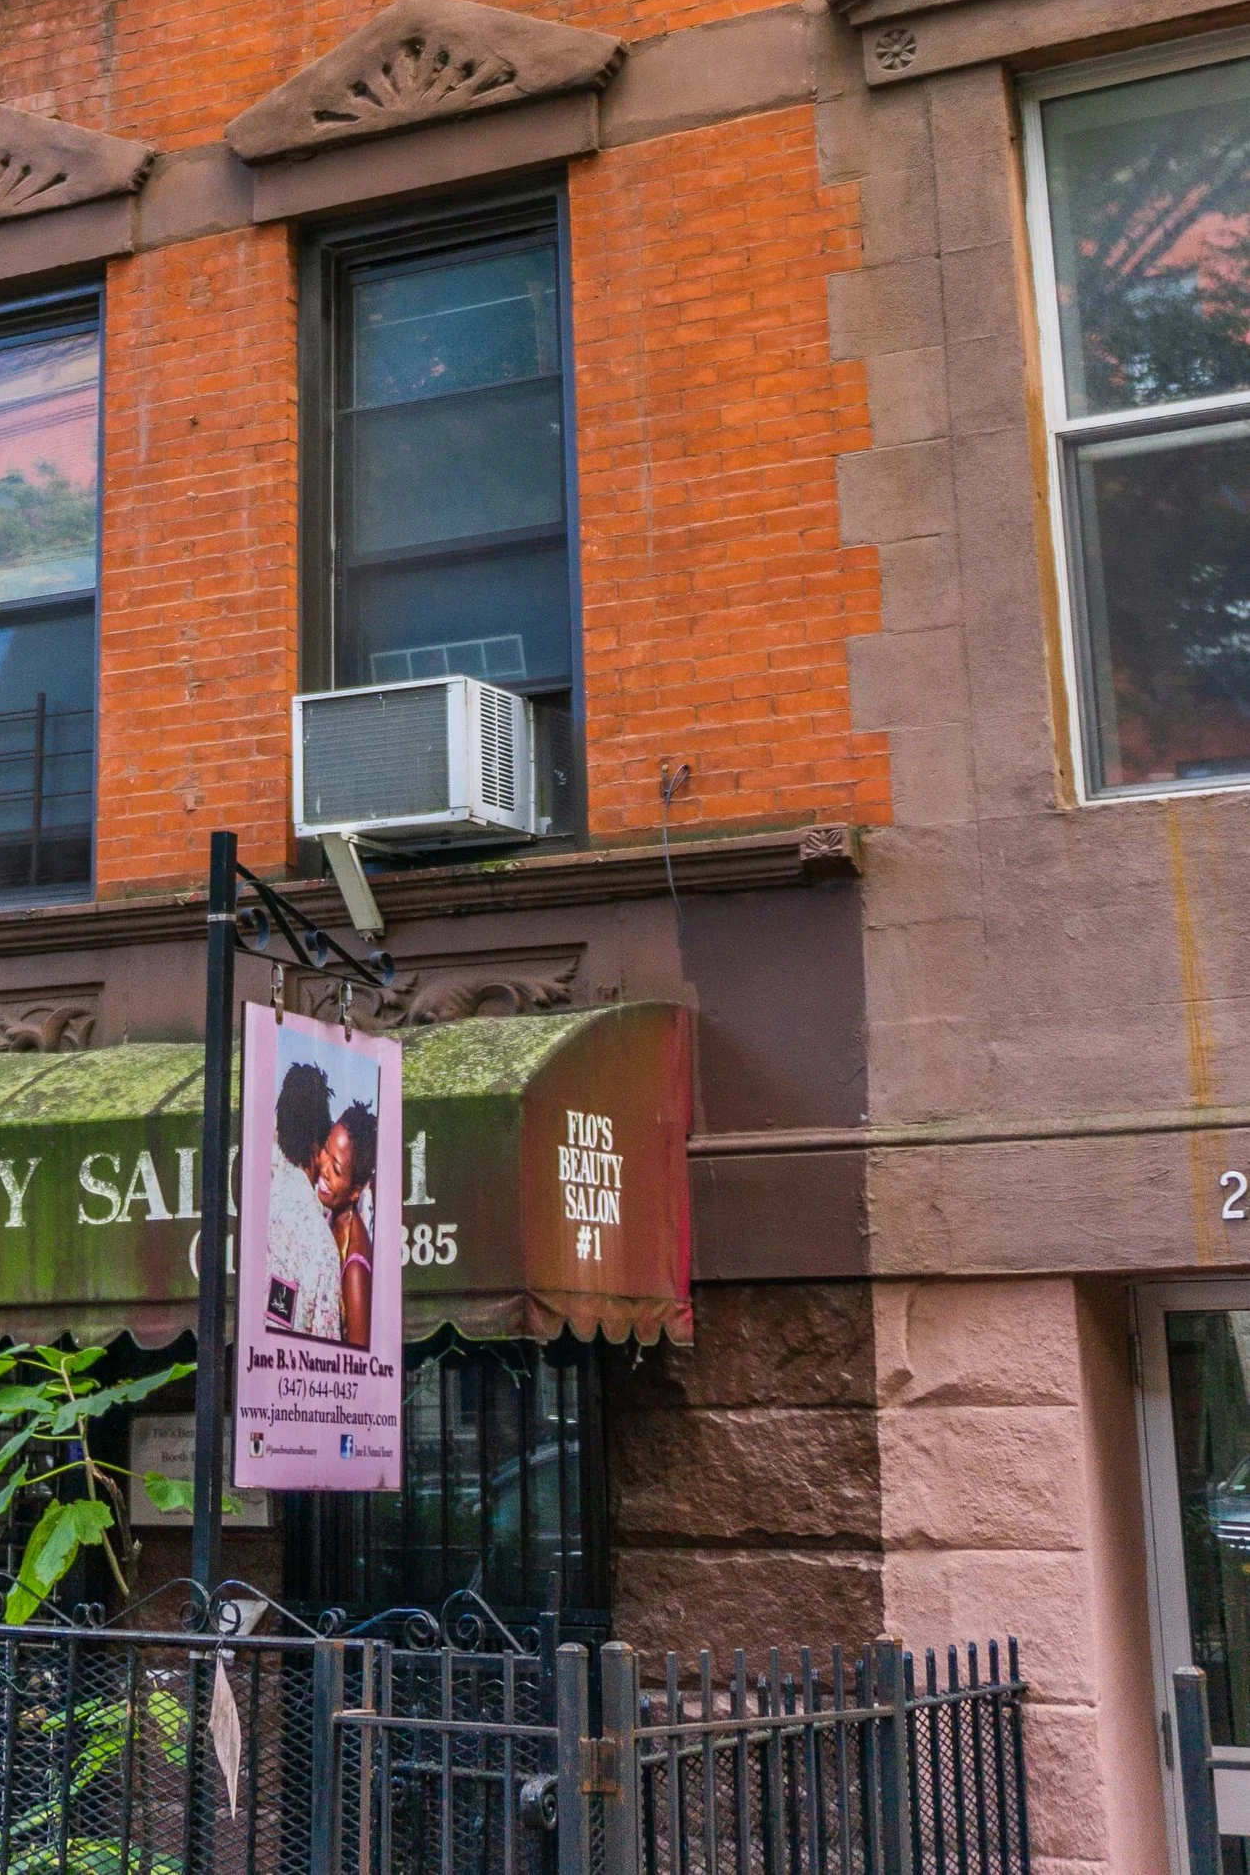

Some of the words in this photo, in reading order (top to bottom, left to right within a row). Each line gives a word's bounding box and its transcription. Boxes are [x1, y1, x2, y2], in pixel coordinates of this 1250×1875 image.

[566, 1109, 614, 1152] FLO'S
[78, 1145, 239, 1225] SAL
[558, 1144, 624, 1189] BEAUTY
[565, 1183, 621, 1225] SALON
[575, 1225, 603, 1261] #1
[246, 1345, 274, 1373] Jane
[298, 1350, 341, 1375] Natural
[342, 1353, 368, 1376] Hair
[369, 1356, 394, 1378] Care
[278, 1376, 307, 1401] (347)
[309, 1378, 359, 1401] 644-0437
[240, 1403, 398, 1432] www.janebnaturalbeauty.com
